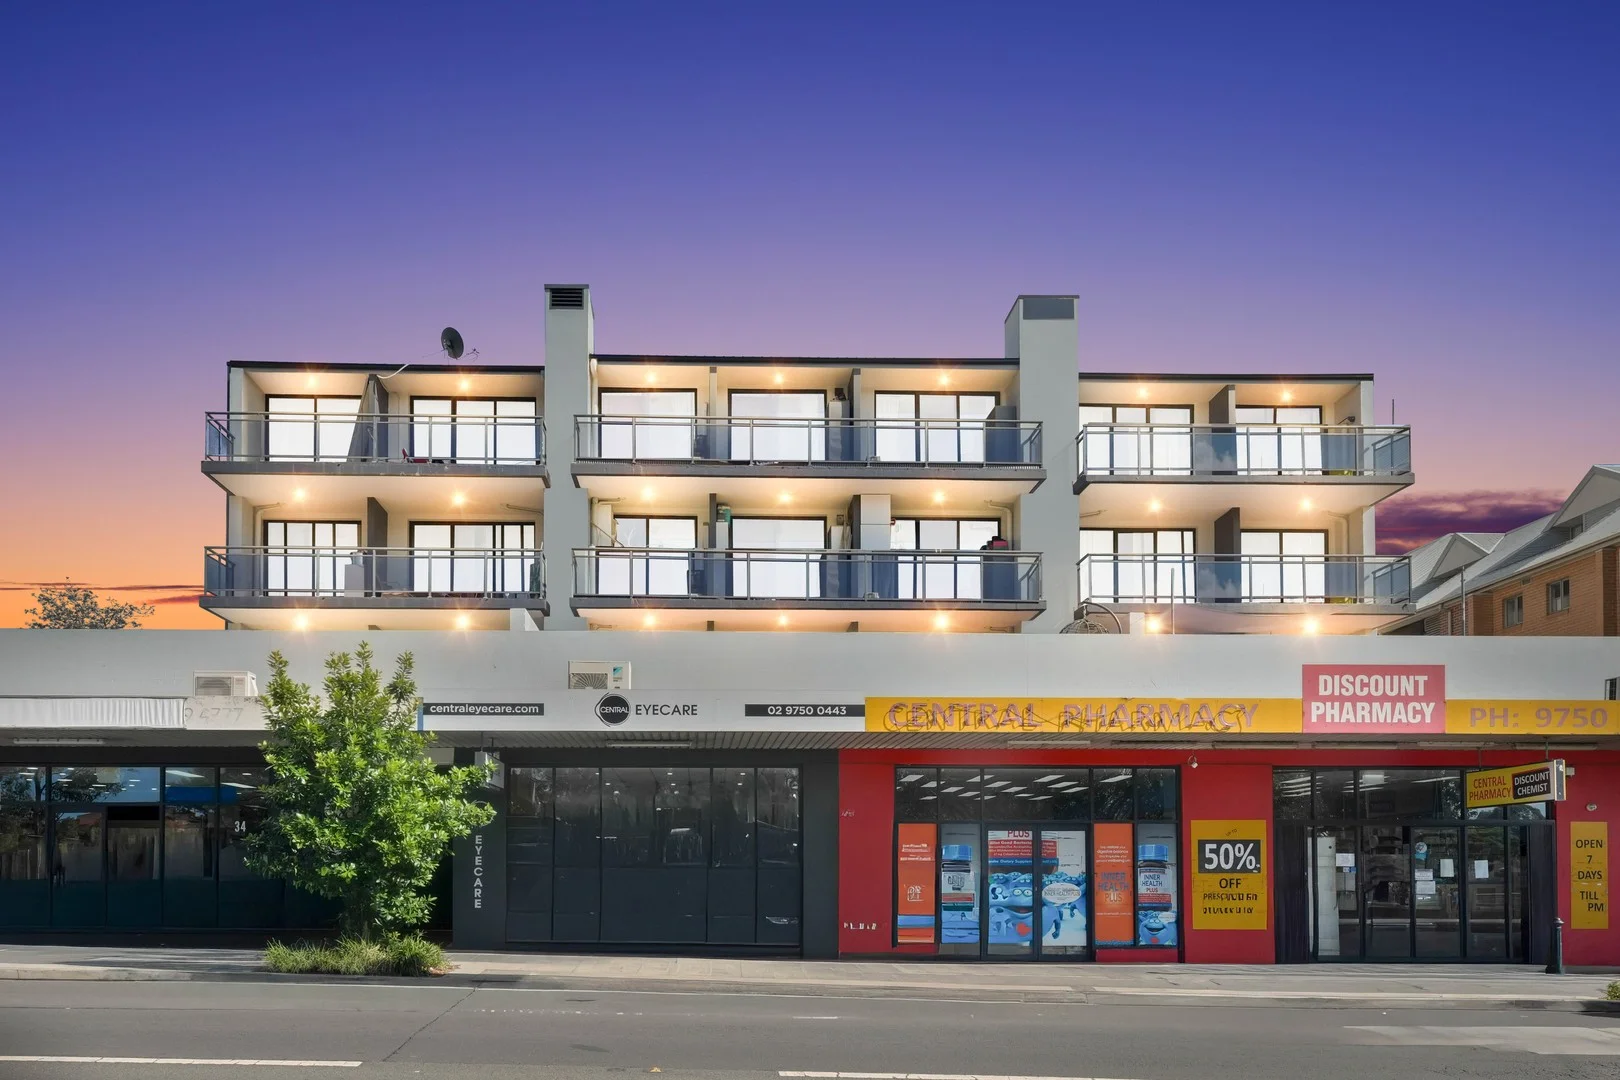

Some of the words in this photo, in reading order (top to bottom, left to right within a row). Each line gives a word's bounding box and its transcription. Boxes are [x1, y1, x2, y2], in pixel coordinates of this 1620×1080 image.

[1318, 674, 1429, 697] DISCOUNT
[429, 703, 540, 716] centraleyecare.com
[600, 706, 630, 714] CENTRAL
[635, 704, 698, 716] EYECARE
[767, 705, 783, 716] 02
[785, 705, 815, 716] 9750
[816, 705, 847, 716] 0443
[1310, 700, 1437, 724] PHARMACY
[888, 702, 1043, 729] CENTRAL
[1063, 702, 1259, 730] PHARMACY
[1469, 707, 1520, 728] PH:
[1535, 707, 1608, 729] 9750
[1473, 776, 1507, 789] CENTRAL
[1514, 771, 1550, 786] DISCOUNT
[1469, 787, 1511, 801] PHARMACY
[1517, 783, 1548, 796] CHEMIST
[234, 820, 247, 833] 34
[1575, 838, 1603, 849] OPEN
[1204, 842, 1256, 870] 50%
[1586, 854, 1593, 864] 7
[473, 835, 483, 909] EYECARE
[1100, 872, 1126, 880] INNER
[1577, 870, 1603, 880] DAYS
[1098, 882, 1129, 891] HEALTH
[1219, 878, 1242, 889] OFF
[1105, 892, 1122, 902] PLUS
[1579, 890, 1598, 900] TILL
[1587, 902, 1604, 912] PM
